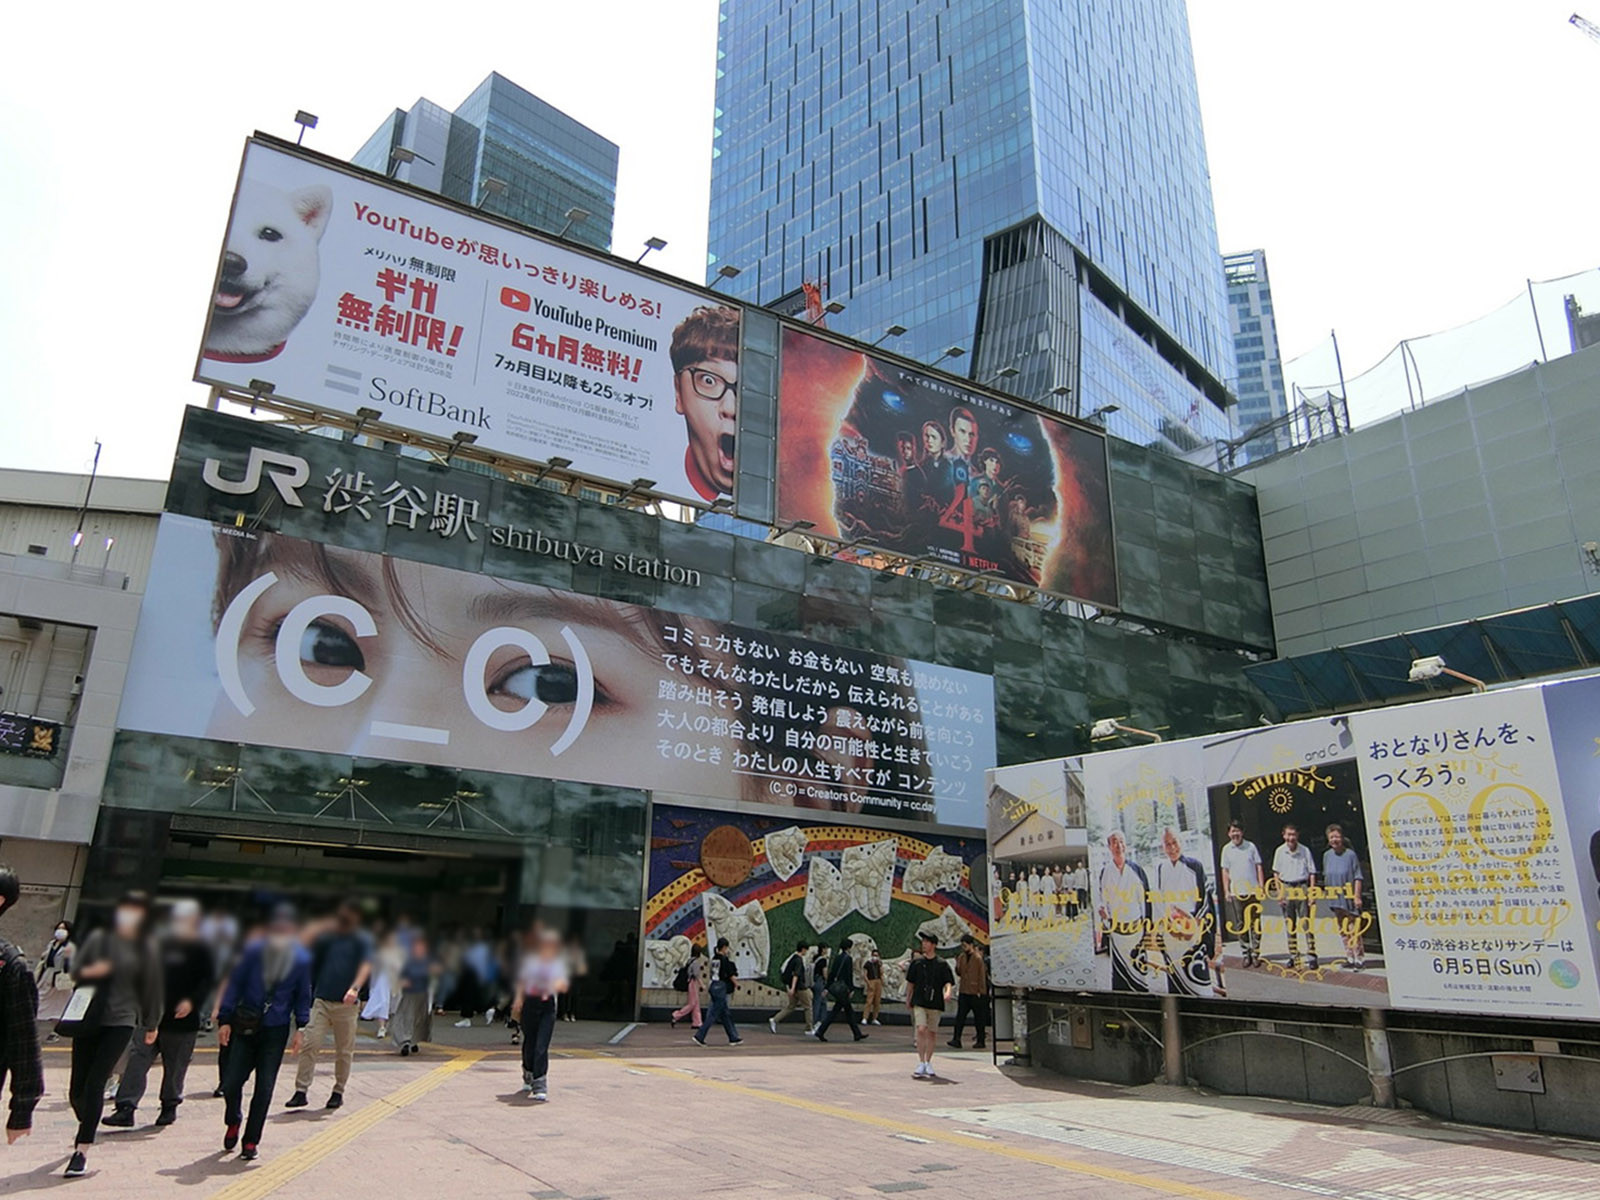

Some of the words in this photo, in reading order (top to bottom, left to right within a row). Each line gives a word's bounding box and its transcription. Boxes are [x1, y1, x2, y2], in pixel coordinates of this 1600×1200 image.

[353, 202, 661, 319] YouTubeが思いっきり楽しめる!
[376, 267, 438, 314] ギガ
[336, 292, 464, 357] 無制限!
[534, 297, 593, 332] YouTube
[596, 318, 658, 352] Premium
[369, 377, 491, 430] SoftBank
[202, 447, 310, 508] JR
[322, 467, 480, 542] 渋谷駅
[491, 524, 605, 566] shibuya
[613, 551, 701, 587] station
[939, 483, 984, 554] 4
[968, 556, 999, 570] NETFLIX
[663, 625, 780, 660] コミュ力もない
[787, 649, 864, 675] お金もない
[870, 663, 968, 695] 空気も読めない
[658, 679, 743, 711] 踏み出そう
[752, 695, 829, 725] 発信しよう
[836, 708, 975, 747] 震えながら前を向こう
[662, 654, 840, 699] でもそんなわたしだから
[847, 685, 984, 724] 伝えられることがある
[656, 738, 723, 765] そのとき
[733, 751, 891, 787] わたしの人生すべてが
[899, 773, 967, 796] コンテンツ
[657, 710, 775, 744] 大人の都合より
[785, 729, 973, 773] 自分の可能性と生きていこう
[1305, 749, 1326, 761] and
[1370, 722, 1537, 760] おとなりさんを、
[807, 785, 849, 802] Creators
[850, 792, 902, 810] Community
[1244, 771, 1316, 800] SHIBUYA
[1373, 764, 1466, 790] つくろう。
[1225, 902, 1372, 948] Sunday
[1394, 937, 1575, 953] 今年の渋谷おとなりサンデーは
[1433, 957, 1542, 976] 6月5日(Sun)
